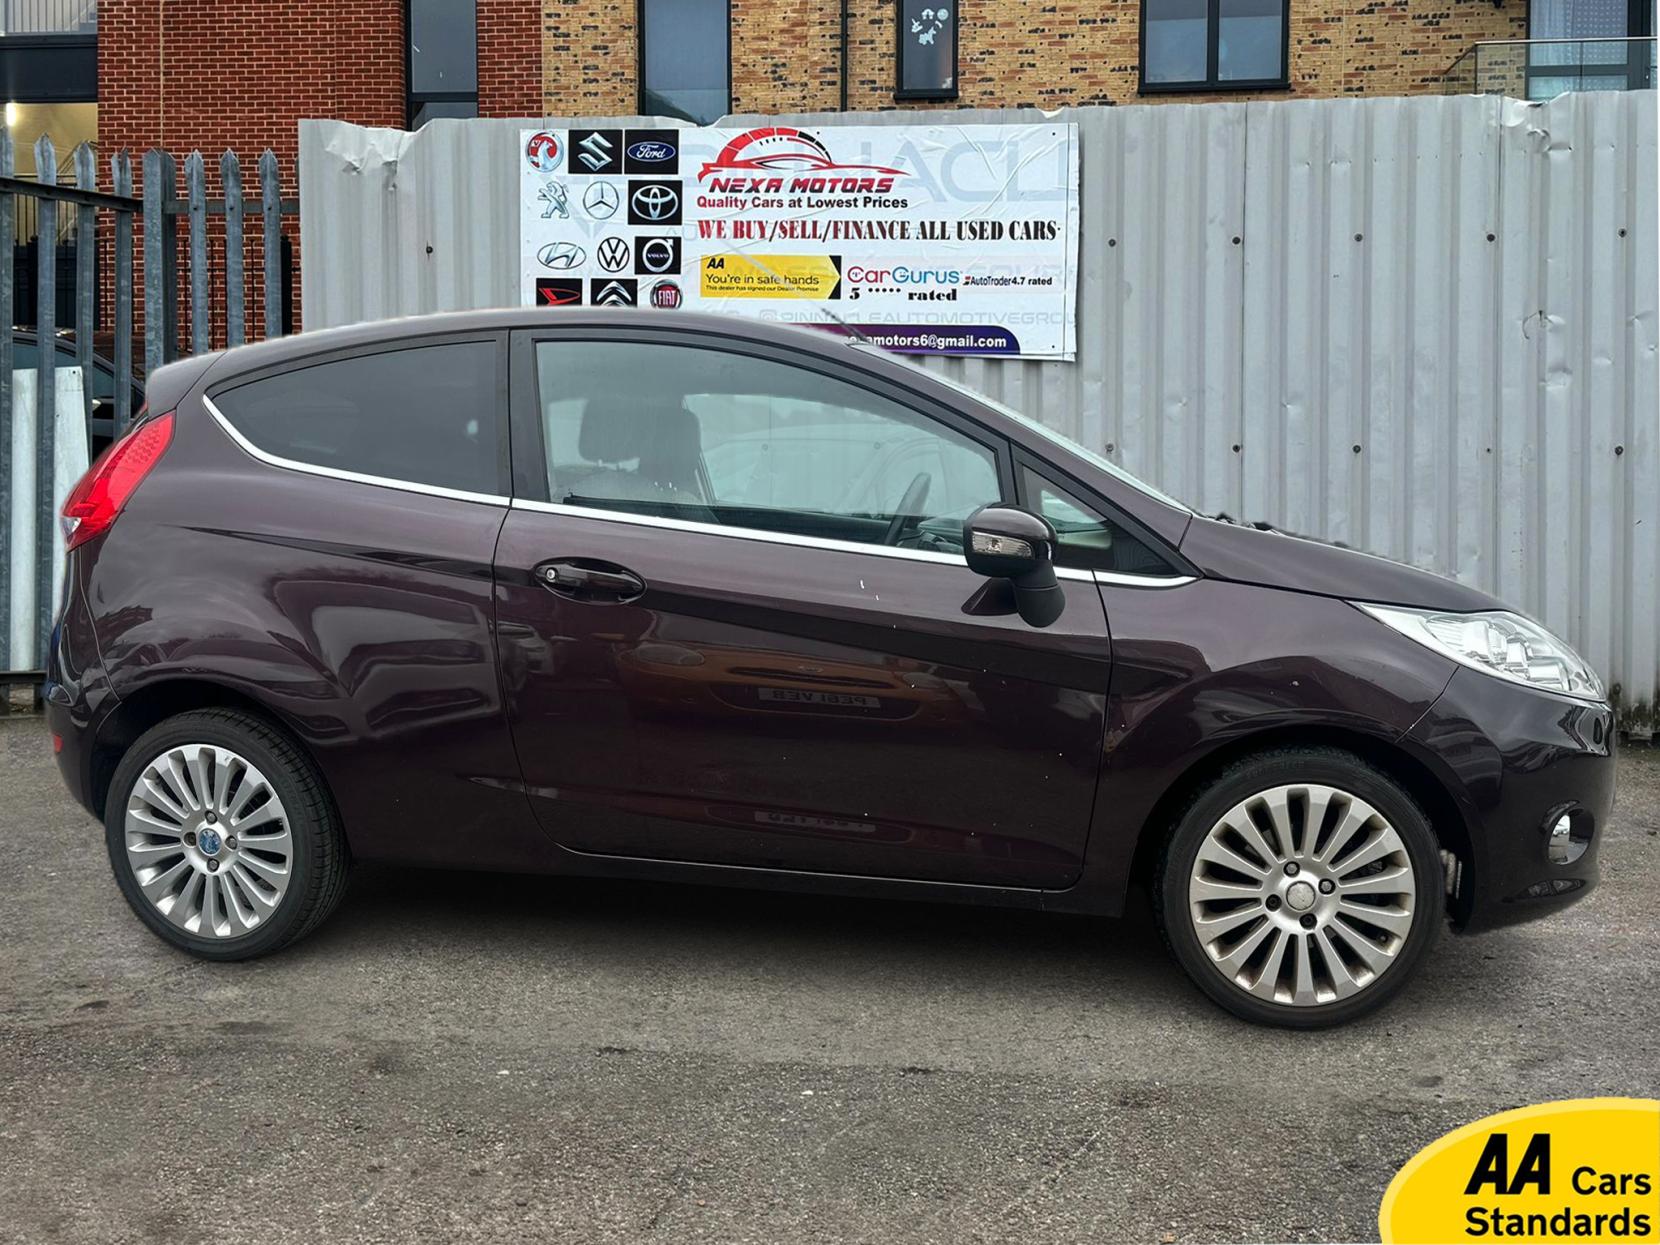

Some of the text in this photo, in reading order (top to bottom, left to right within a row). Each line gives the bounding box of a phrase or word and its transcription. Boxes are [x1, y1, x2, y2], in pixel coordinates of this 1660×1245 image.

[636, 144, 666, 159] Ford
[708, 178, 895, 194] NEXA MOTORS
[696, 196, 909, 211] Quality Cars at Lowest Prices
[697, 220, 727, 240] WE
[733, 219, 911, 243] BUY/SELL/FINANCE
[917, 220, 951, 241] ALL
[956, 220, 1004, 241] USED
[706, 257, 725, 270] AA
[706, 273, 820, 285] You're in safe hands
[847, 266, 960, 284] CarGurus
[1028, 276, 1053, 286] rated
[658, 290, 676, 306] FIAT
[849, 287, 957, 301] 5 rated
